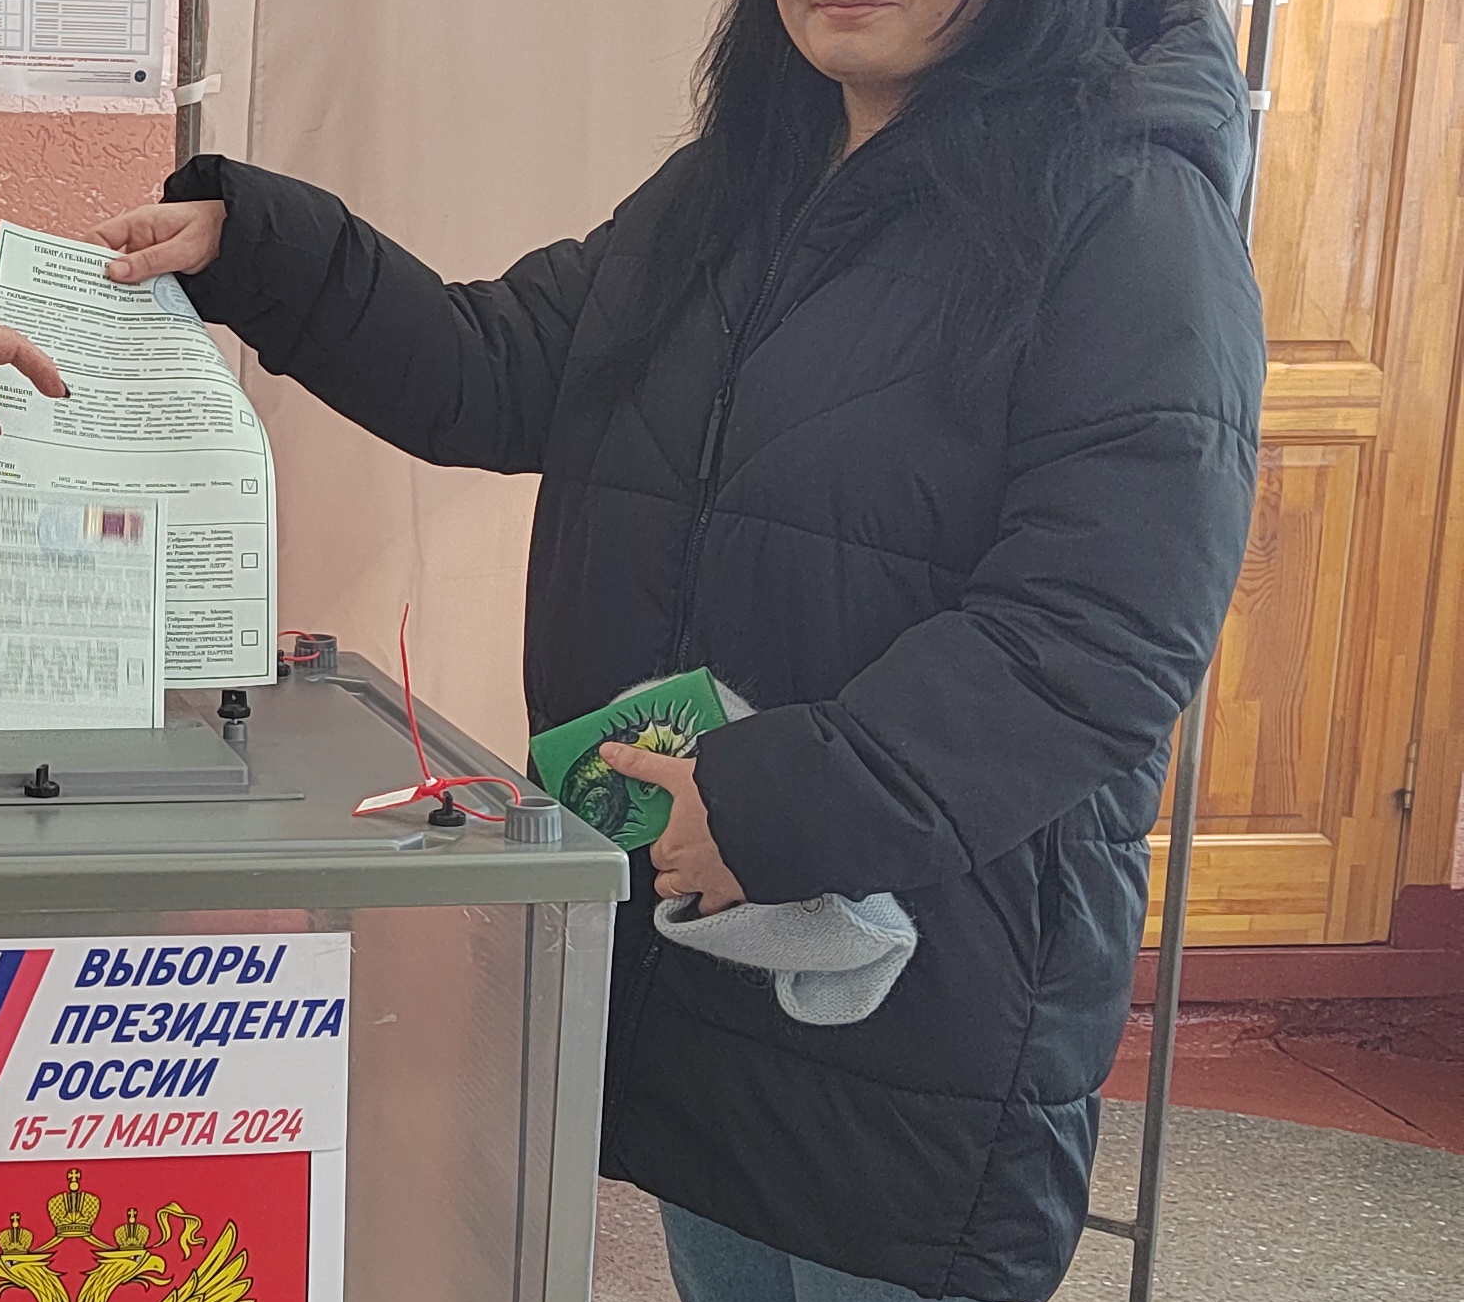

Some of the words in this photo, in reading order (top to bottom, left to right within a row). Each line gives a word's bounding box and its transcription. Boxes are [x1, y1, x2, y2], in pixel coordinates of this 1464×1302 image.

[74, 944, 288, 988] ВЫБОРЫ
[50, 998, 345, 1047] ПРЕЗИДЕНТА
[25, 1057, 220, 1102] РОССИИ
[102, 1111, 219, 1149] МАРТА
[222, 1108, 304, 1145] 2024
